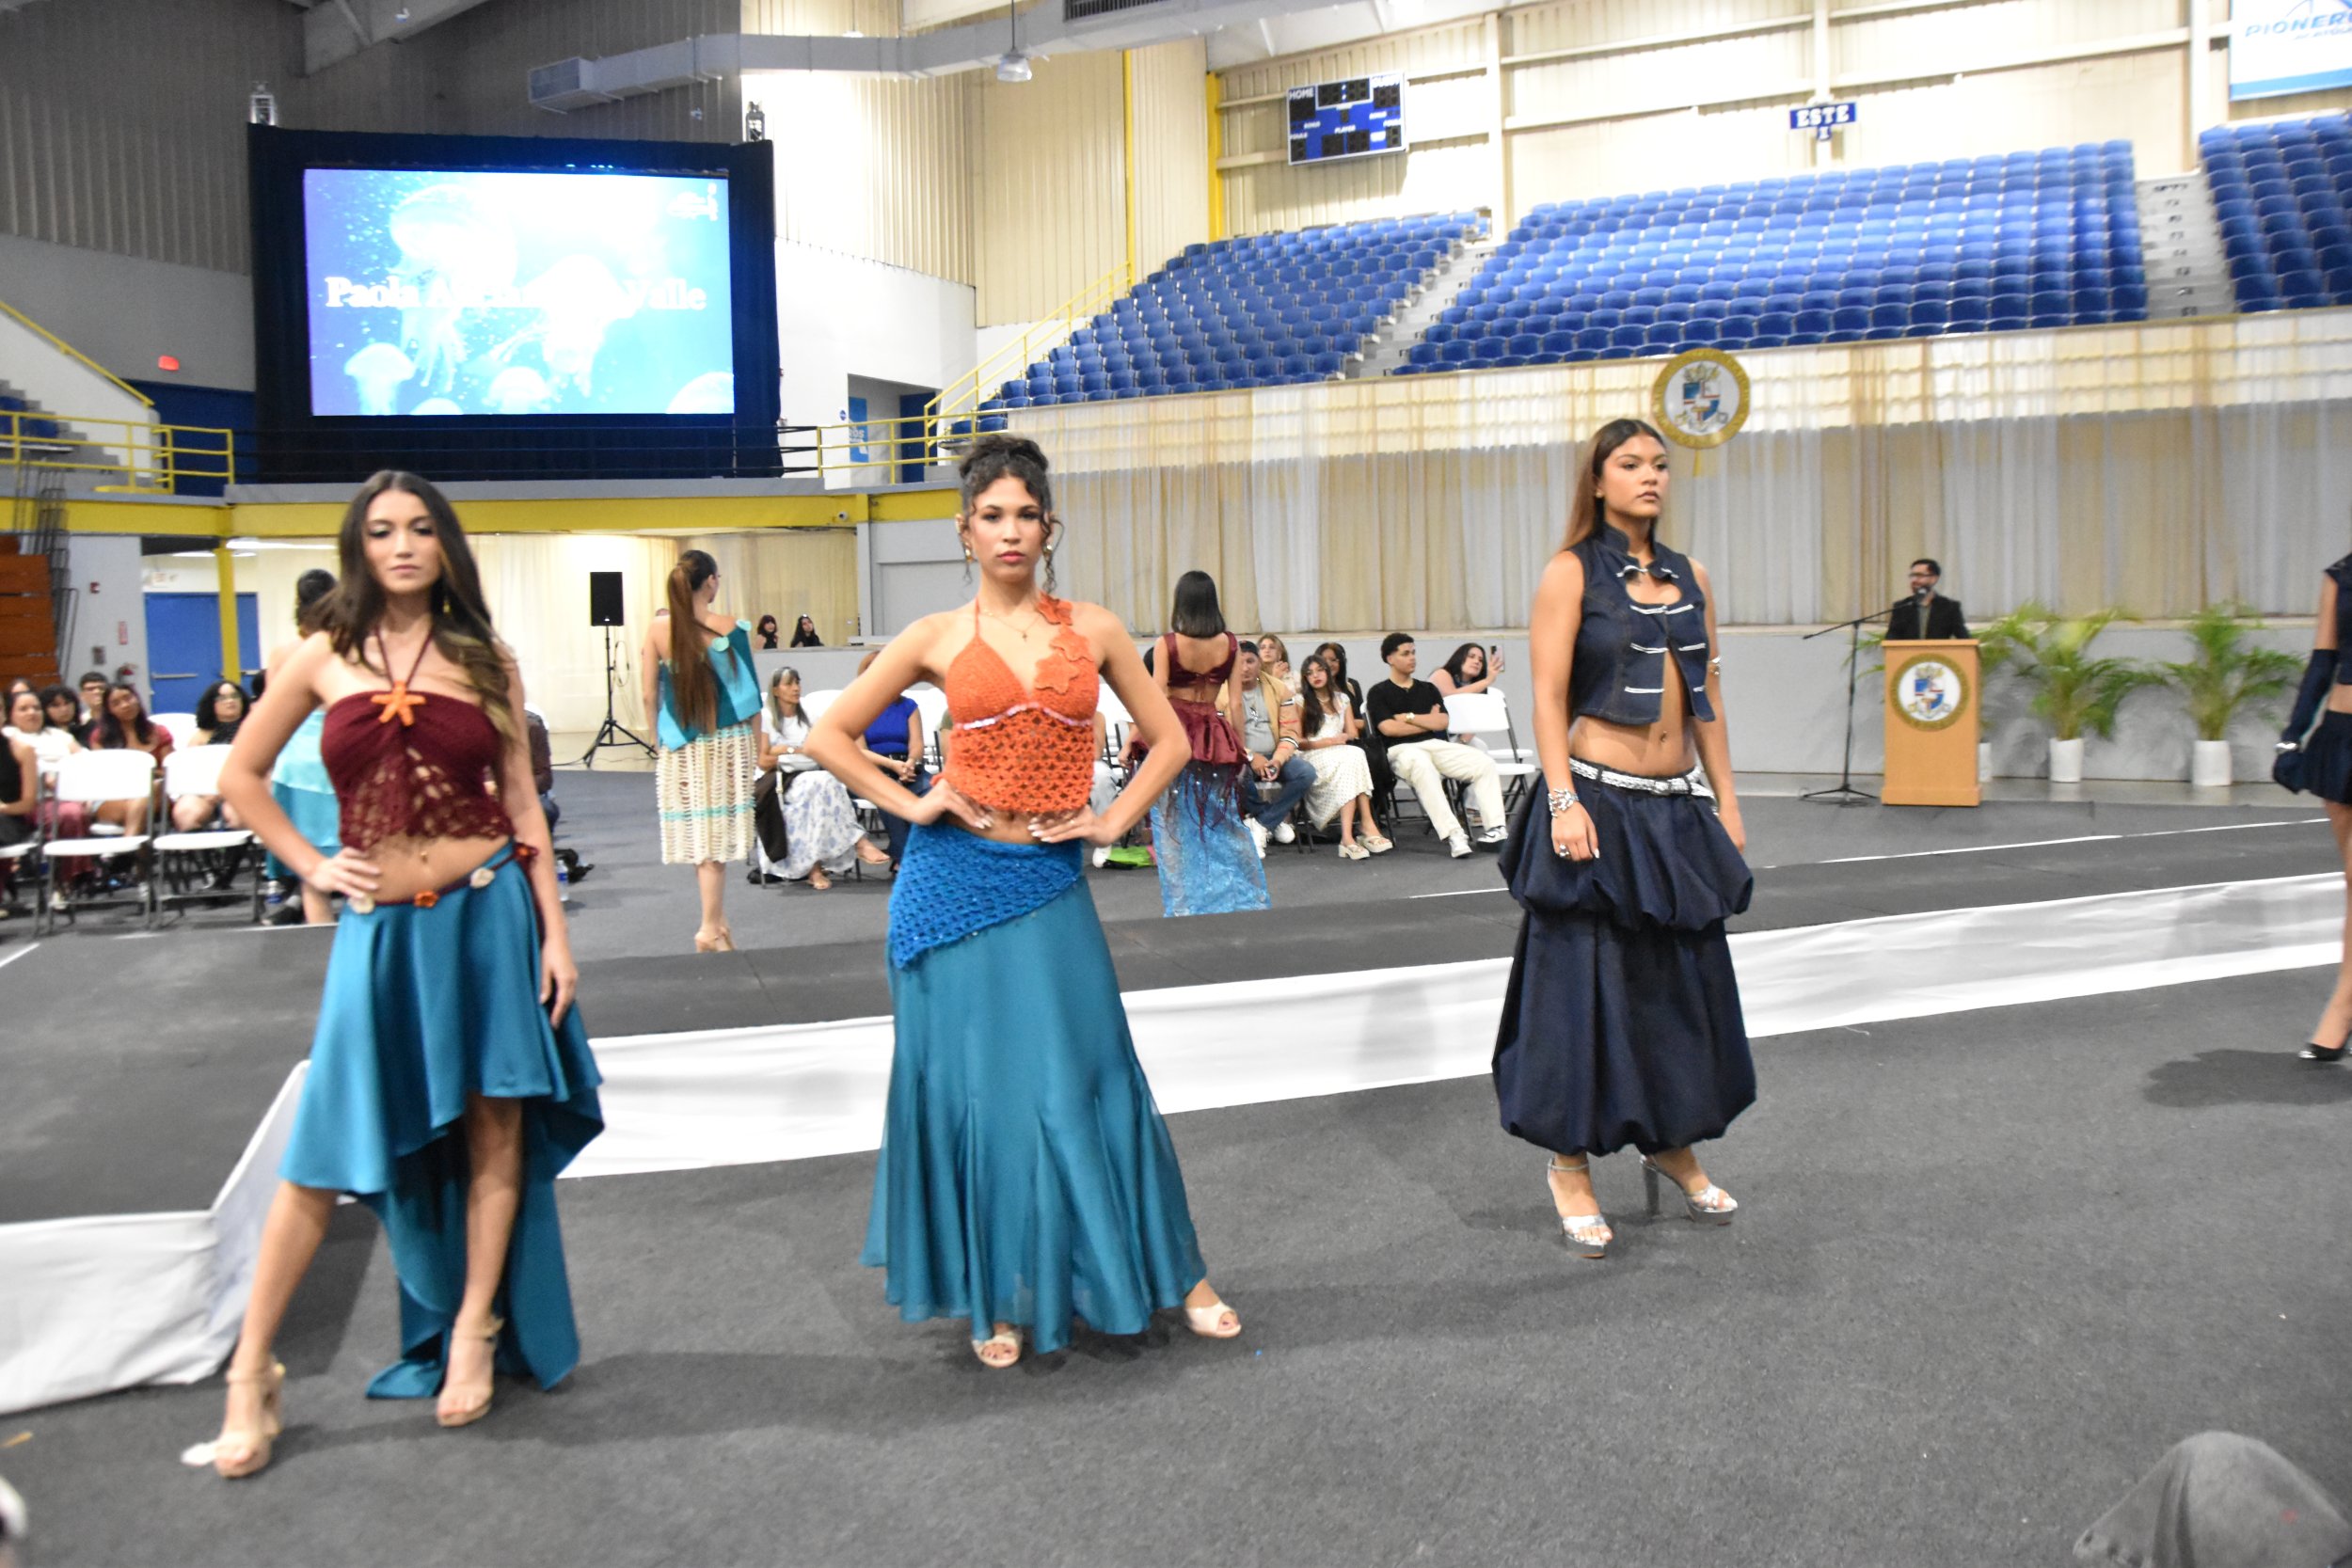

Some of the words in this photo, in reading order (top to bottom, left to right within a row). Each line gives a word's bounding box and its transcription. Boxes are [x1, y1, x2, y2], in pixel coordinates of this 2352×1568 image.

[2245, 10, 2352, 38] PIONER
[1289, 87, 1313, 101] HOME
[1796, 104, 1850, 128] ESTE
[325, 276, 421, 309] Paola
